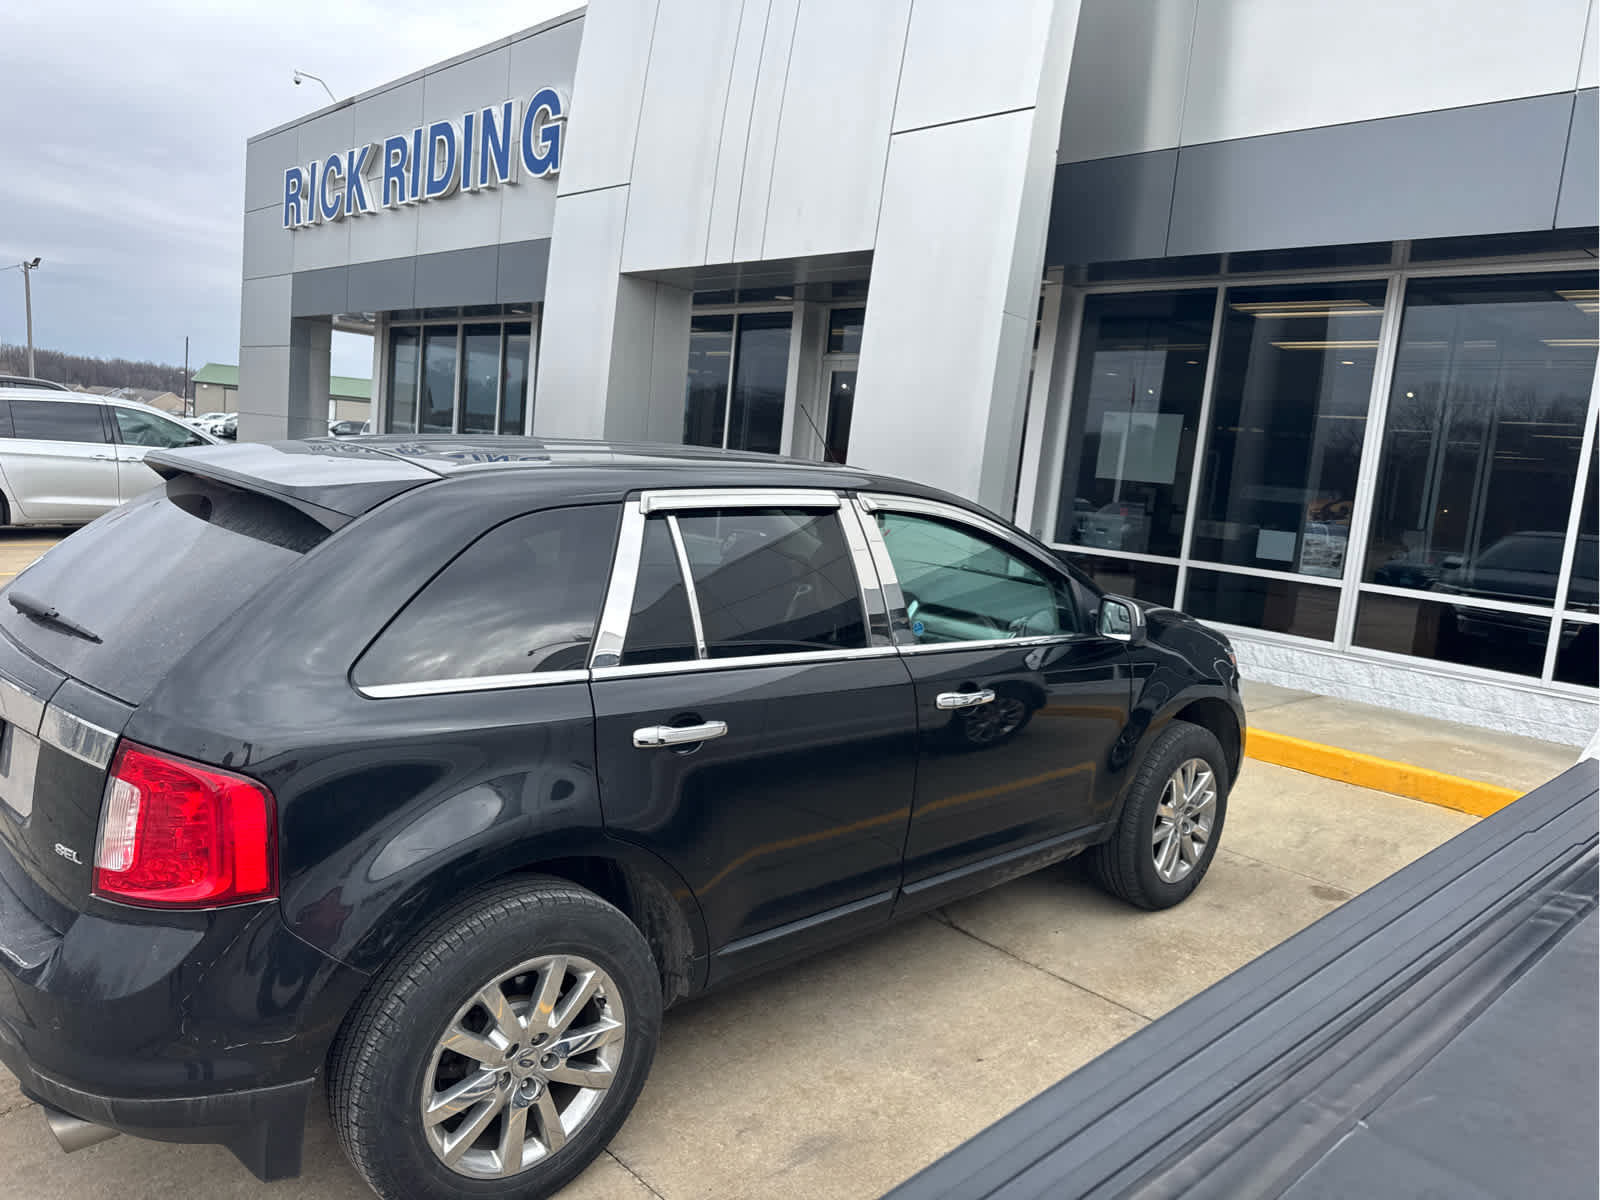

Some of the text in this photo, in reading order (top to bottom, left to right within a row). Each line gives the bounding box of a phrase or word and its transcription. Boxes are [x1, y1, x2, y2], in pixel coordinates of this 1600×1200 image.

[282, 86, 565, 229] RICK RIDING
[55, 843, 83, 865] SEL
